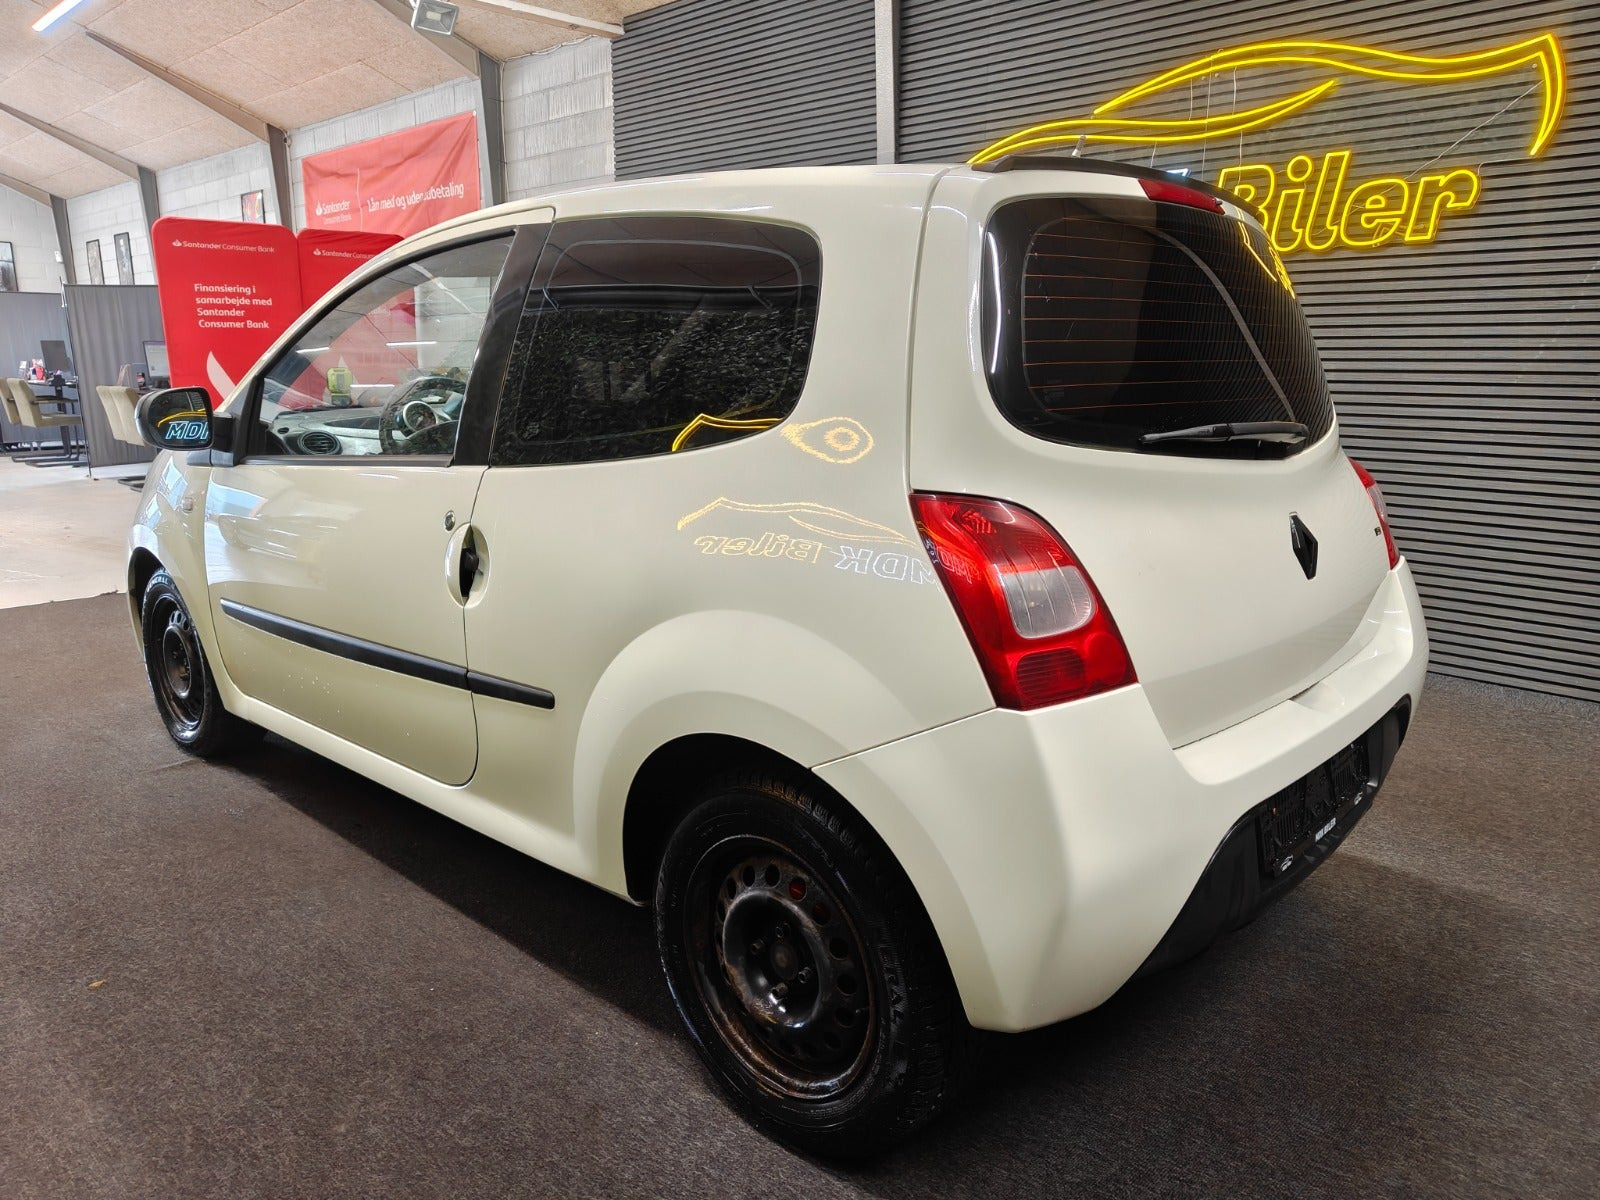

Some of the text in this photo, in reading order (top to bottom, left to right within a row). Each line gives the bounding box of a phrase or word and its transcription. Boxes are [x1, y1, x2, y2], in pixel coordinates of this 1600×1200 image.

[380, 195, 395, 209] med
[396, 194, 406, 210] og
[1217, 150, 1478, 252] Biler
[182, 240, 275, 253] Santander Consumer Bank
[321, 250, 352, 258] Santander
[194, 283, 256, 295] Finansiering i
[195, 296, 273, 306] samarbejde med
[196, 307, 245, 317] Santander
[198, 319, 270, 329] Consumer Bank
